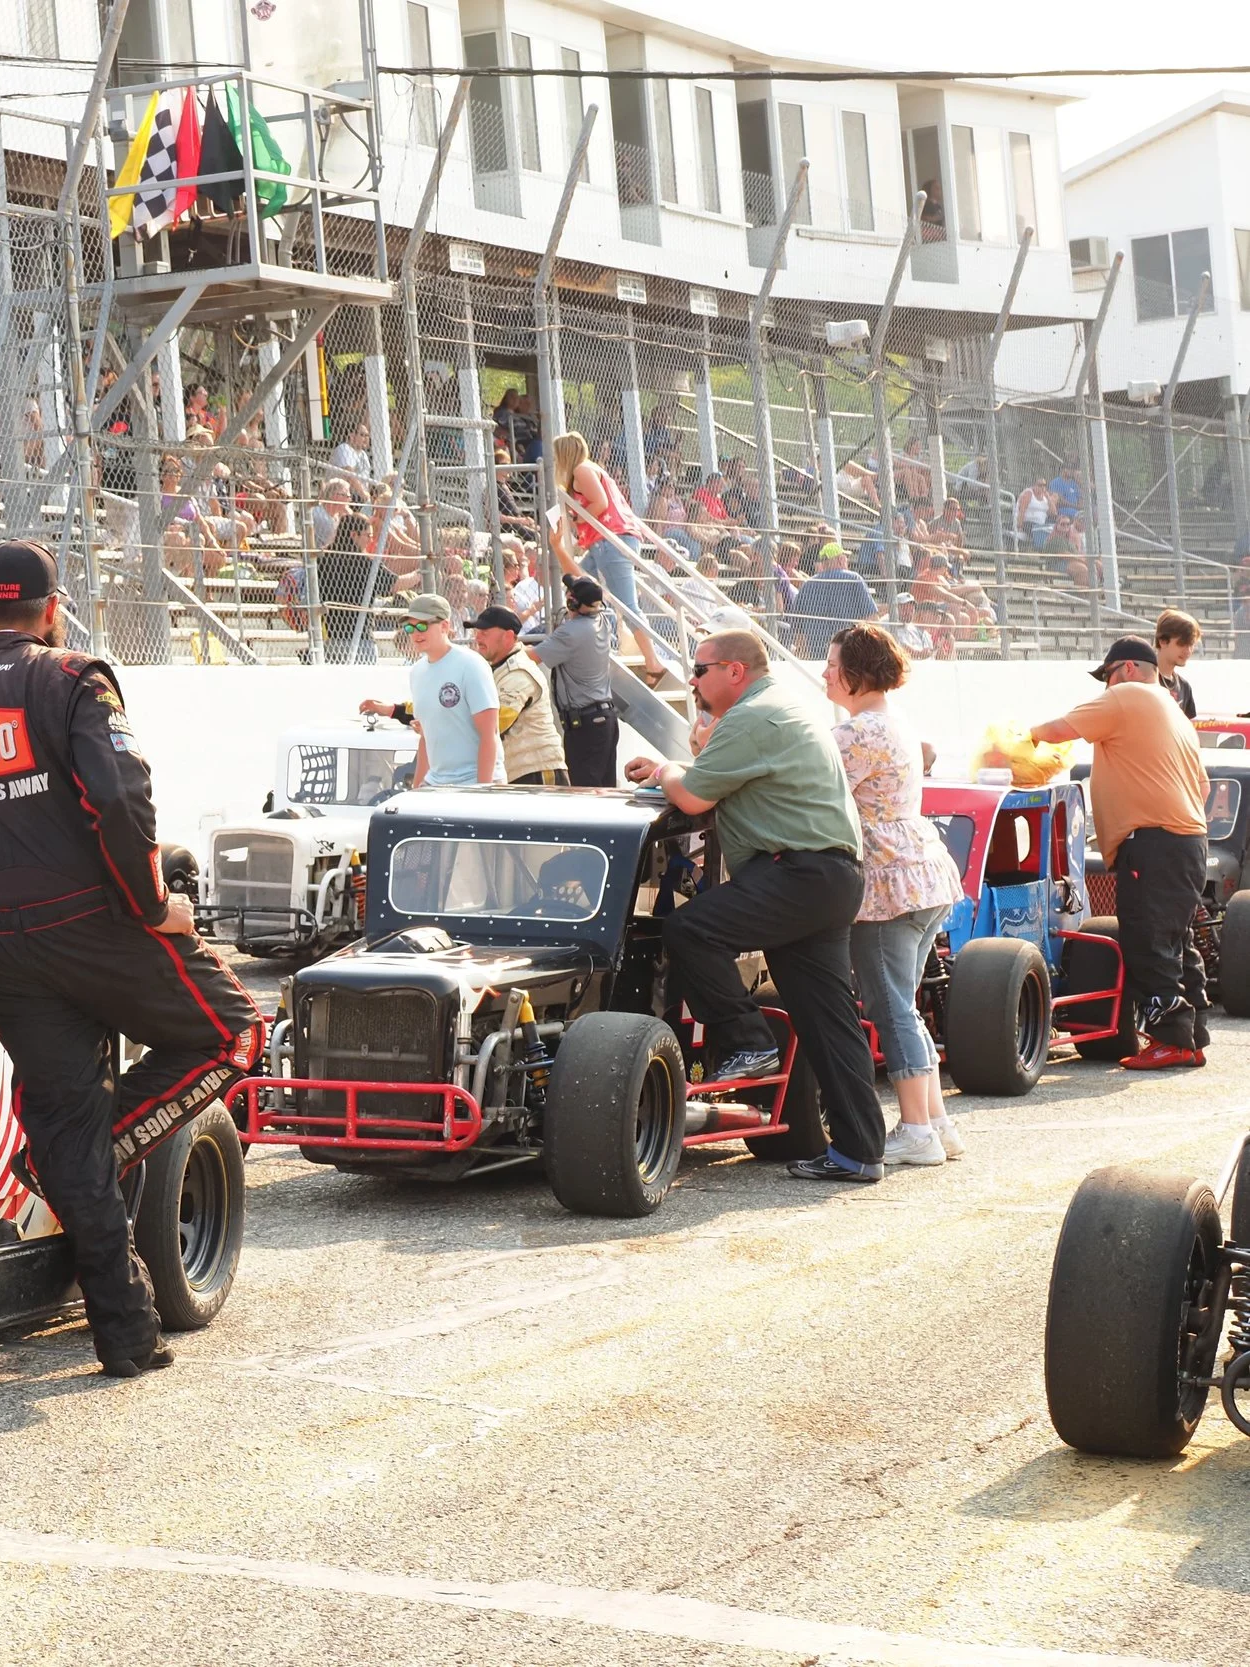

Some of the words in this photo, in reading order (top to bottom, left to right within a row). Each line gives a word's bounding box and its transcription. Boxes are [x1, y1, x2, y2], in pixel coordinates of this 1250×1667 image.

[9, 772, 49, 799] AWAY
[182, 1068, 233, 1110] DRIVE
[134, 1101, 184, 1145] BUGS
